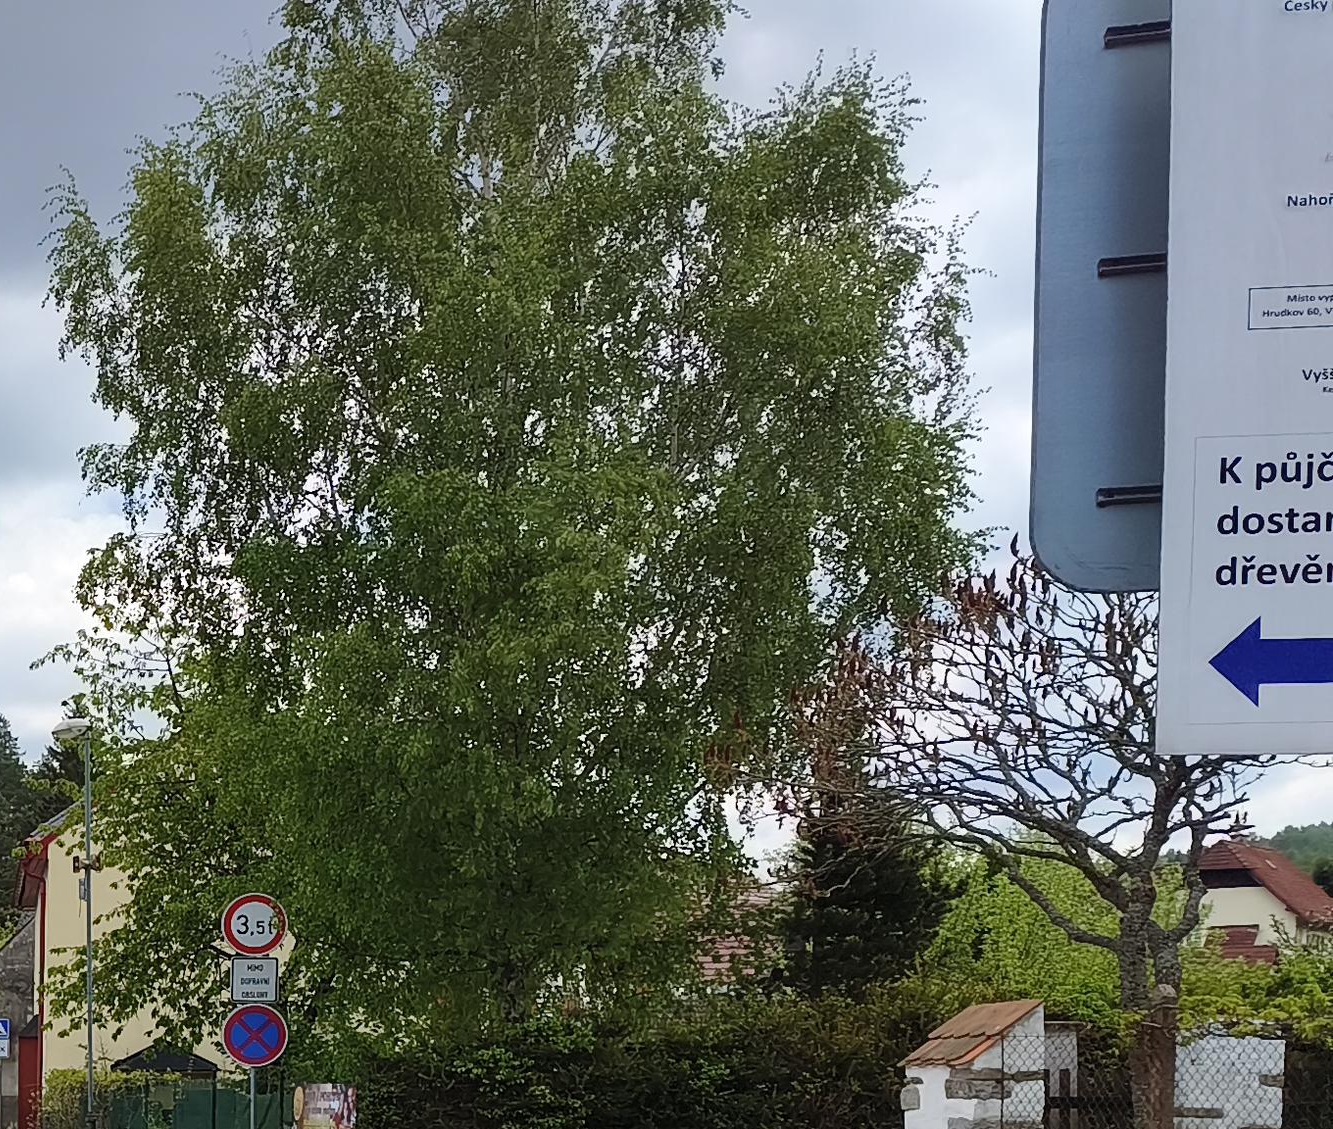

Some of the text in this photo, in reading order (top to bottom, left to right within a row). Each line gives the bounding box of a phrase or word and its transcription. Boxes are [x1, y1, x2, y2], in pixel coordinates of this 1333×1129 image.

[1262, 308, 1305, 318] Hrudkov
[1220, 451, 1333, 490] K půjč
